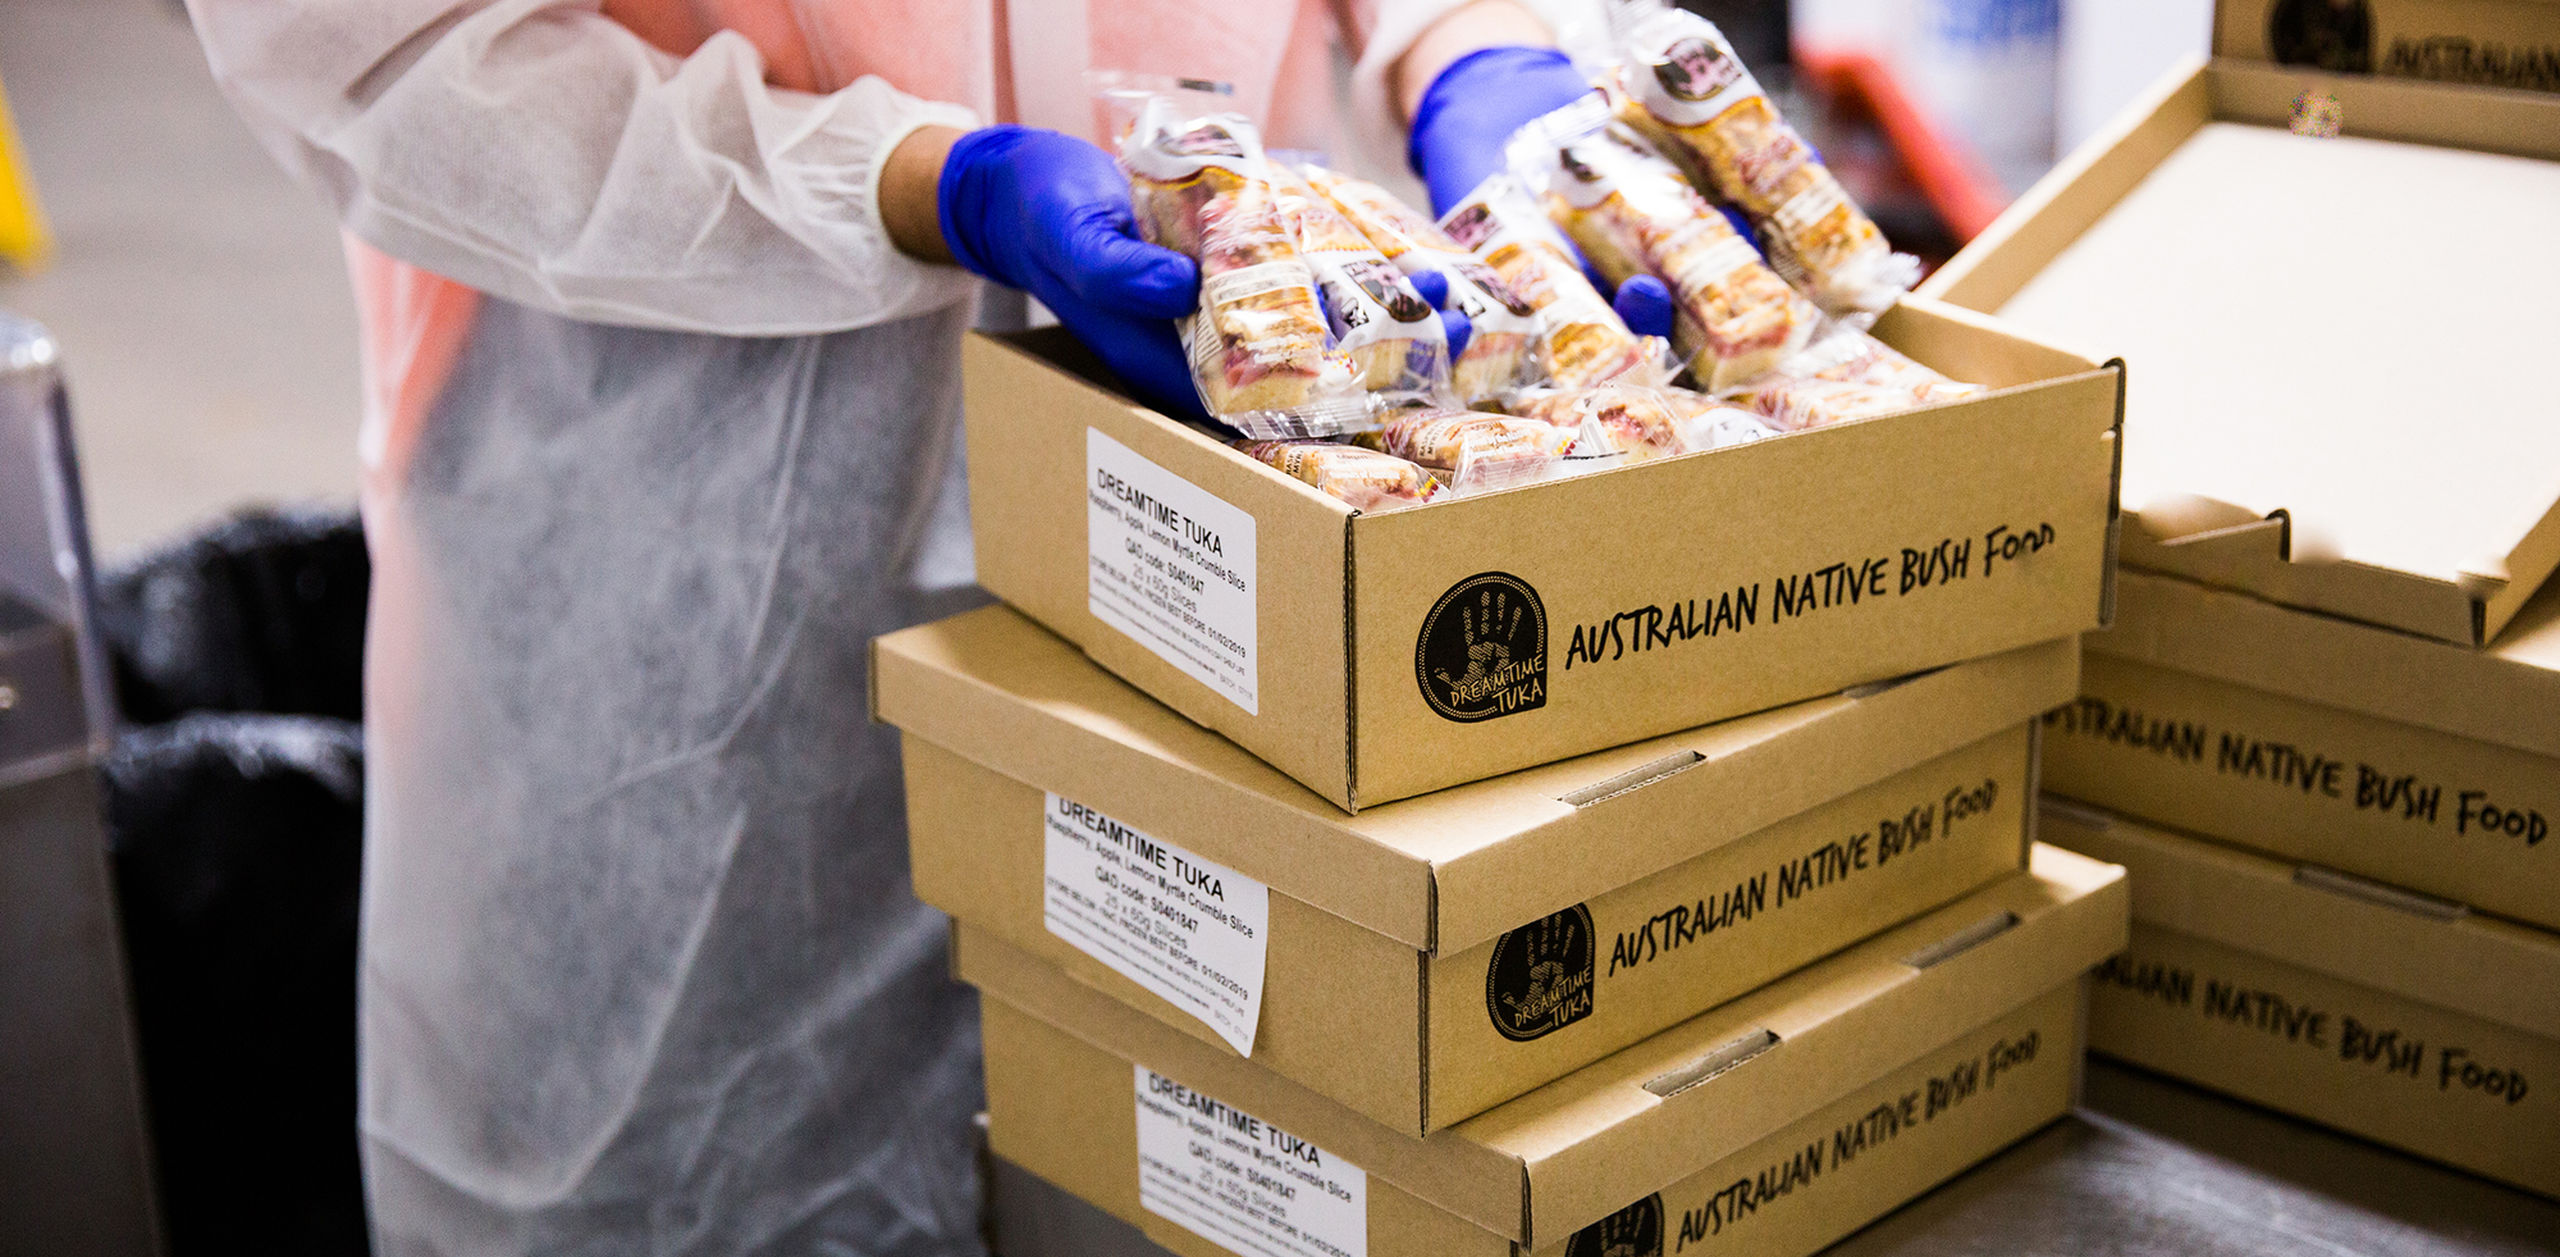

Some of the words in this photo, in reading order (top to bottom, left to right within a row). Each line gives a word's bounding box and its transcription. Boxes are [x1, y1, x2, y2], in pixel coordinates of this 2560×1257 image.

[1097, 468, 1178, 532] DREAMTIME
[1183, 517, 1223, 558] TUKA
[1147, 523, 1171, 548] Lemon
[1172, 537, 1194, 561] Myrtle
[1196, 551, 1226, 580] Crumble
[1227, 570, 1246, 592] Slice
[1171, 585, 1197, 613] Slices
[1565, 583, 1760, 671] AUSTRALIAN
[1773, 558, 1888, 625] NATIVE
[1899, 537, 1971, 596] BUSH
[1208, 627, 1246, 658] 01/02/2019
[1450, 653, 1544, 707] DREAMTIME
[1492, 678, 1543, 713] TUKA
[2217, 731, 2345, 798] NATIVE
[2355, 763, 2442, 823] BUSH
[1059, 798, 1167, 871] DREAMTIME
[1172, 856, 1225, 903] TUKA
[1125, 856, 1157, 885] Lemon
[1158, 876, 1186, 901] Myrtle
[1188, 892, 1228, 925] Crumble
[1230, 915, 1253, 939] Slice
[1150, 897, 1199, 934] S0401847
[1608, 871, 1768, 977] AUSTRALIAN
[1777, 831, 1872, 908] NATIVE
[1876, 803, 1937, 865] BUSH
[1154, 920, 1188, 949] Slices
[1202, 964, 1248, 1001] 01/02/2019
[1515, 966, 1592, 1028] DREAMTIME
[1549, 989, 1591, 1027] TUKA
[2203, 978, 2330, 1044] NATIVE
[2339, 1016, 2425, 1079] BUSH
[1148, 1071, 1260, 1141] DREAMTIME
[1267, 1126, 1321, 1169] TUKA
[1284, 1161, 1325, 1190] Crumble
[1327, 1180, 1352, 1203] Slice
[1676, 1138, 1825, 1254] AUSTRALIAN
[1831, 1091, 1918, 1171] NATIVE
[1922, 1060, 1981, 1122] BUSH
